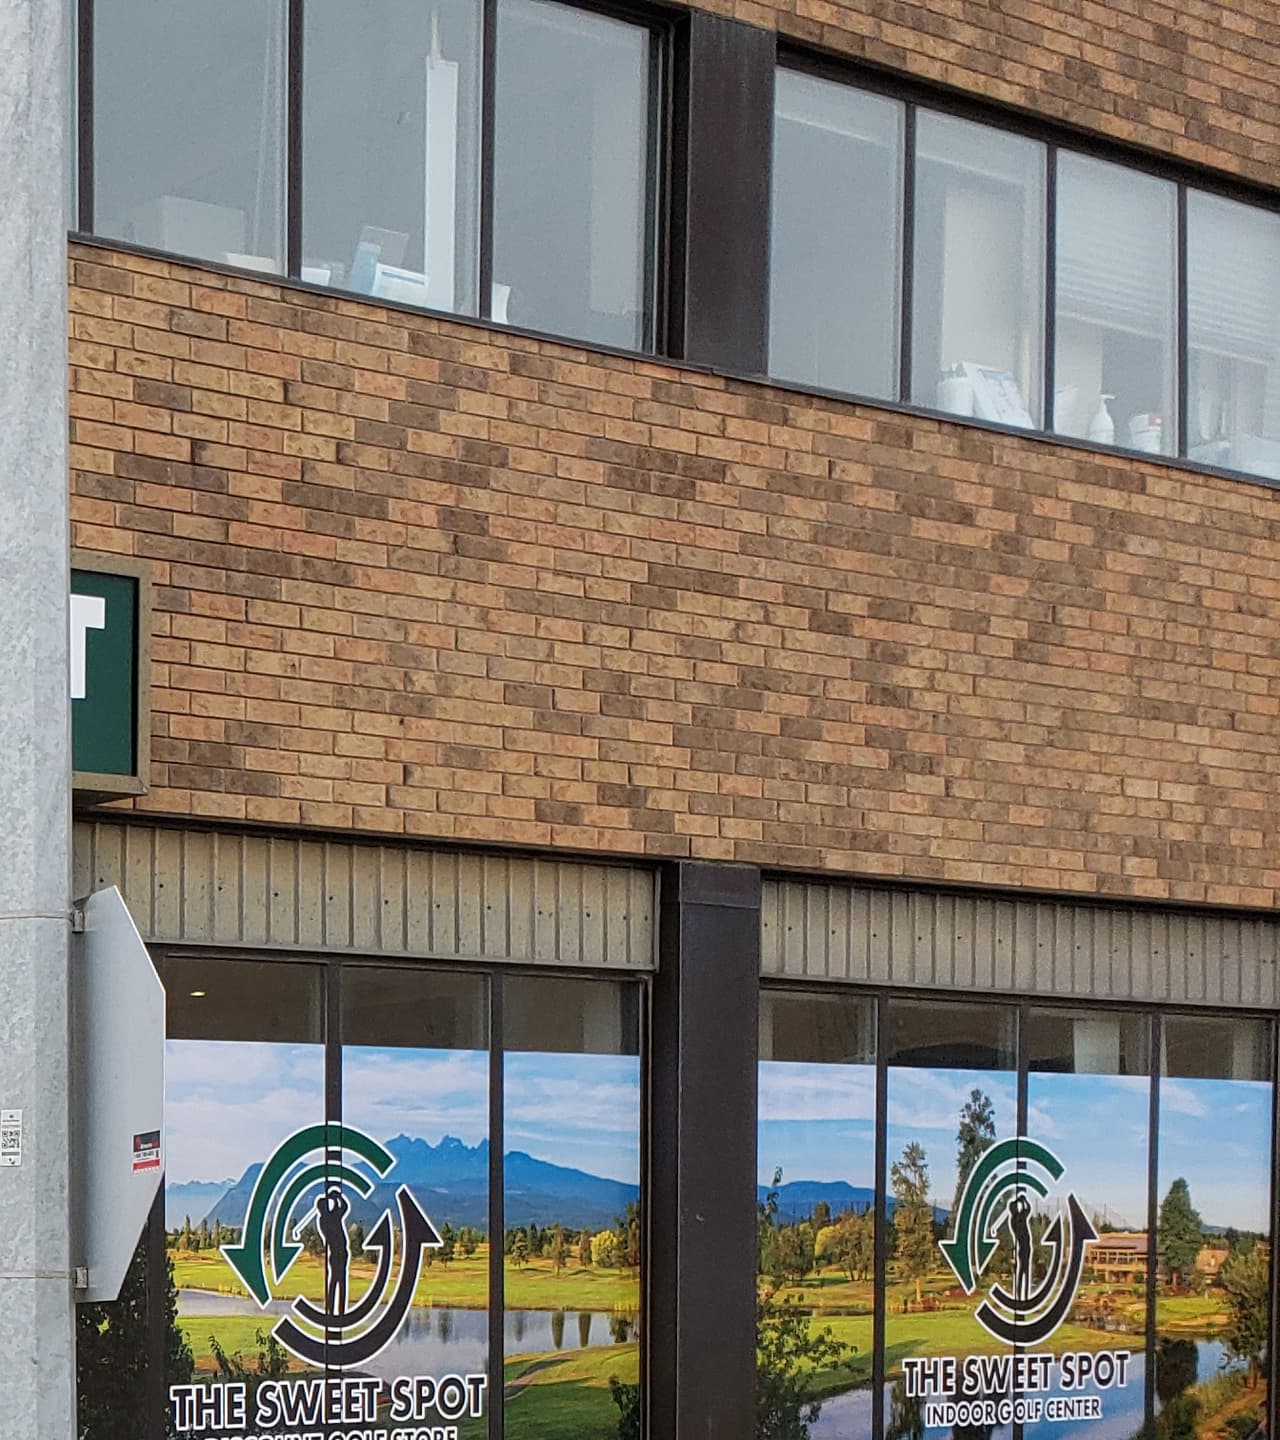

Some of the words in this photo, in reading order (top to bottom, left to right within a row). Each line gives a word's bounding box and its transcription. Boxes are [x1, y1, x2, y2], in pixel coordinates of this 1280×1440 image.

[902, 1358, 956, 1397] THE
[962, 1353, 1055, 1394] SWEET
[1060, 1350, 1131, 1389] SPOT
[170, 1383, 246, 1431] THE
[255, 1378, 383, 1427] SWEET
[390, 1374, 487, 1420] SPOT
[925, 1400, 997, 1427] INDOOR
[998, 1398, 1042, 1424] GOLF
[1046, 1396, 1102, 1421] CENTER
